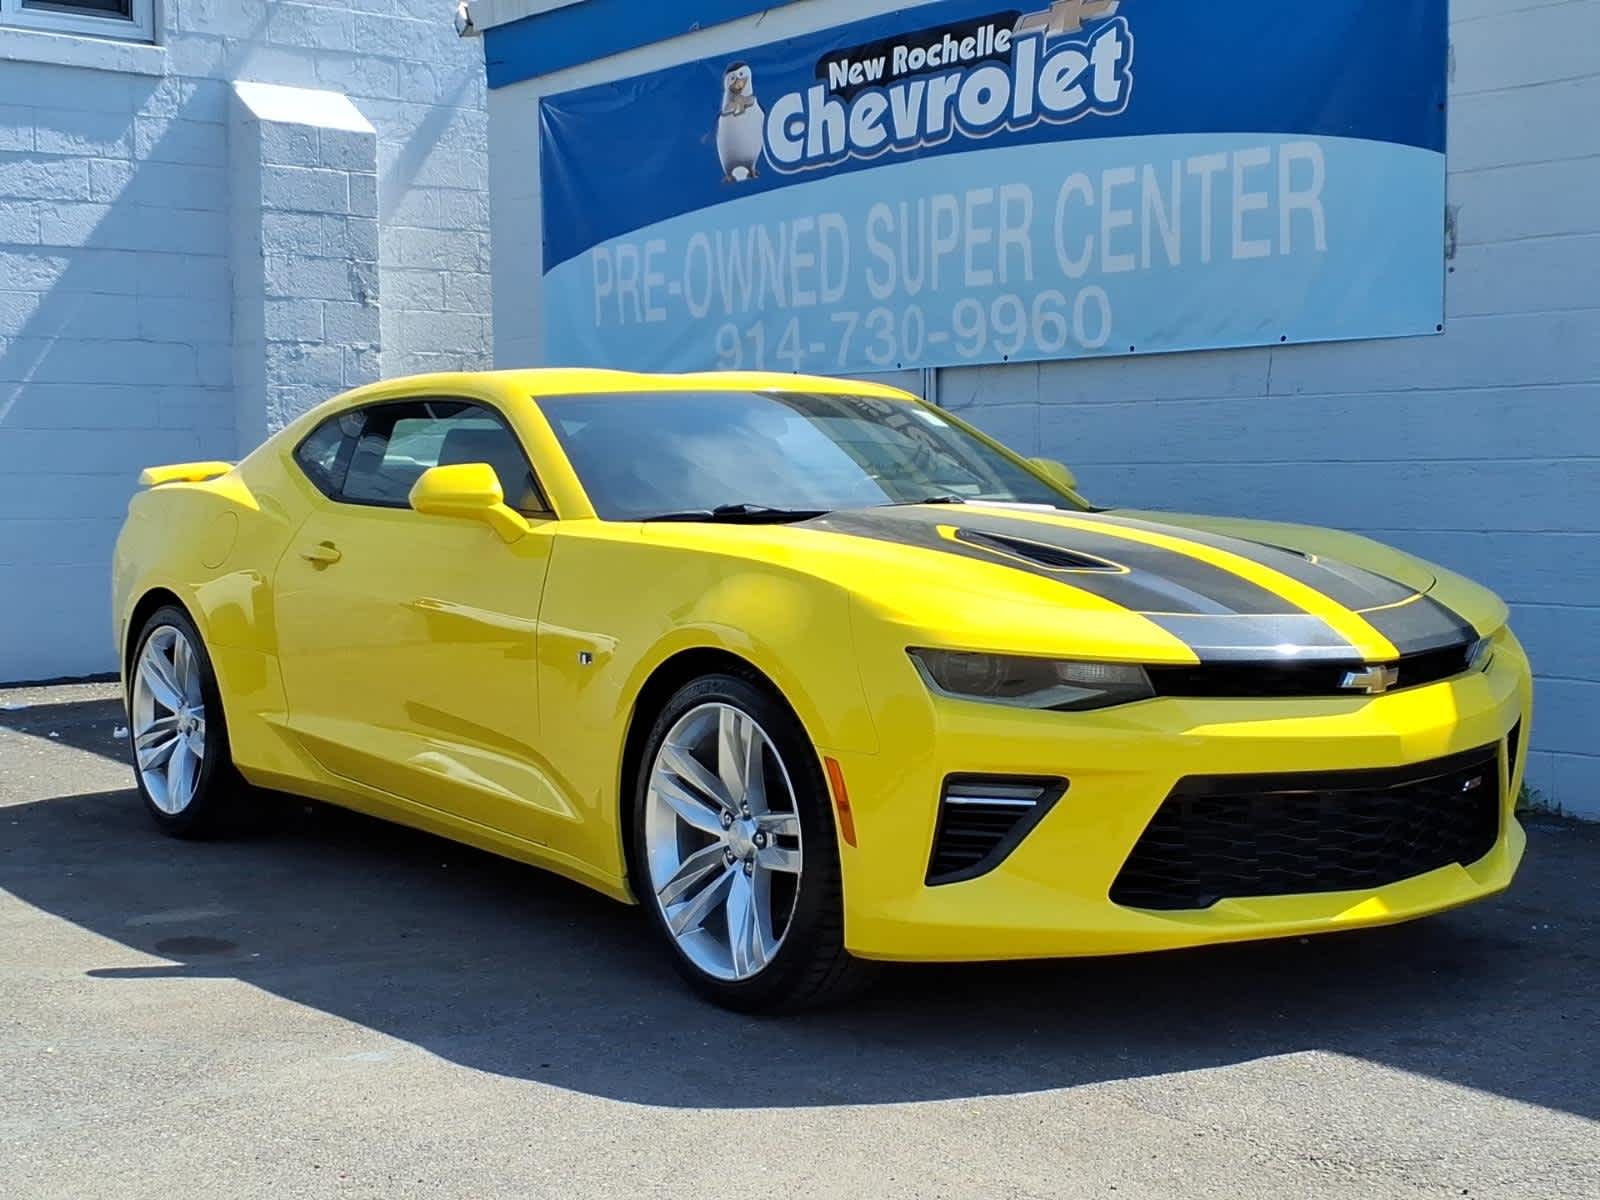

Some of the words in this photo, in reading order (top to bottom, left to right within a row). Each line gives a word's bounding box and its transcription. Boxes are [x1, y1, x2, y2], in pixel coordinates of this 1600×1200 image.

[766, 27, 1123, 164] Chevrolet
[828, 57, 883, 89] New
[892, 25, 1010, 76] Rochelle
[592, 212, 849, 327] PRE-OWNED
[865, 182, 1033, 299] SUPER
[1053, 141, 1327, 279] CENTER
[715, 286, 1112, 370] 914-730-9960
